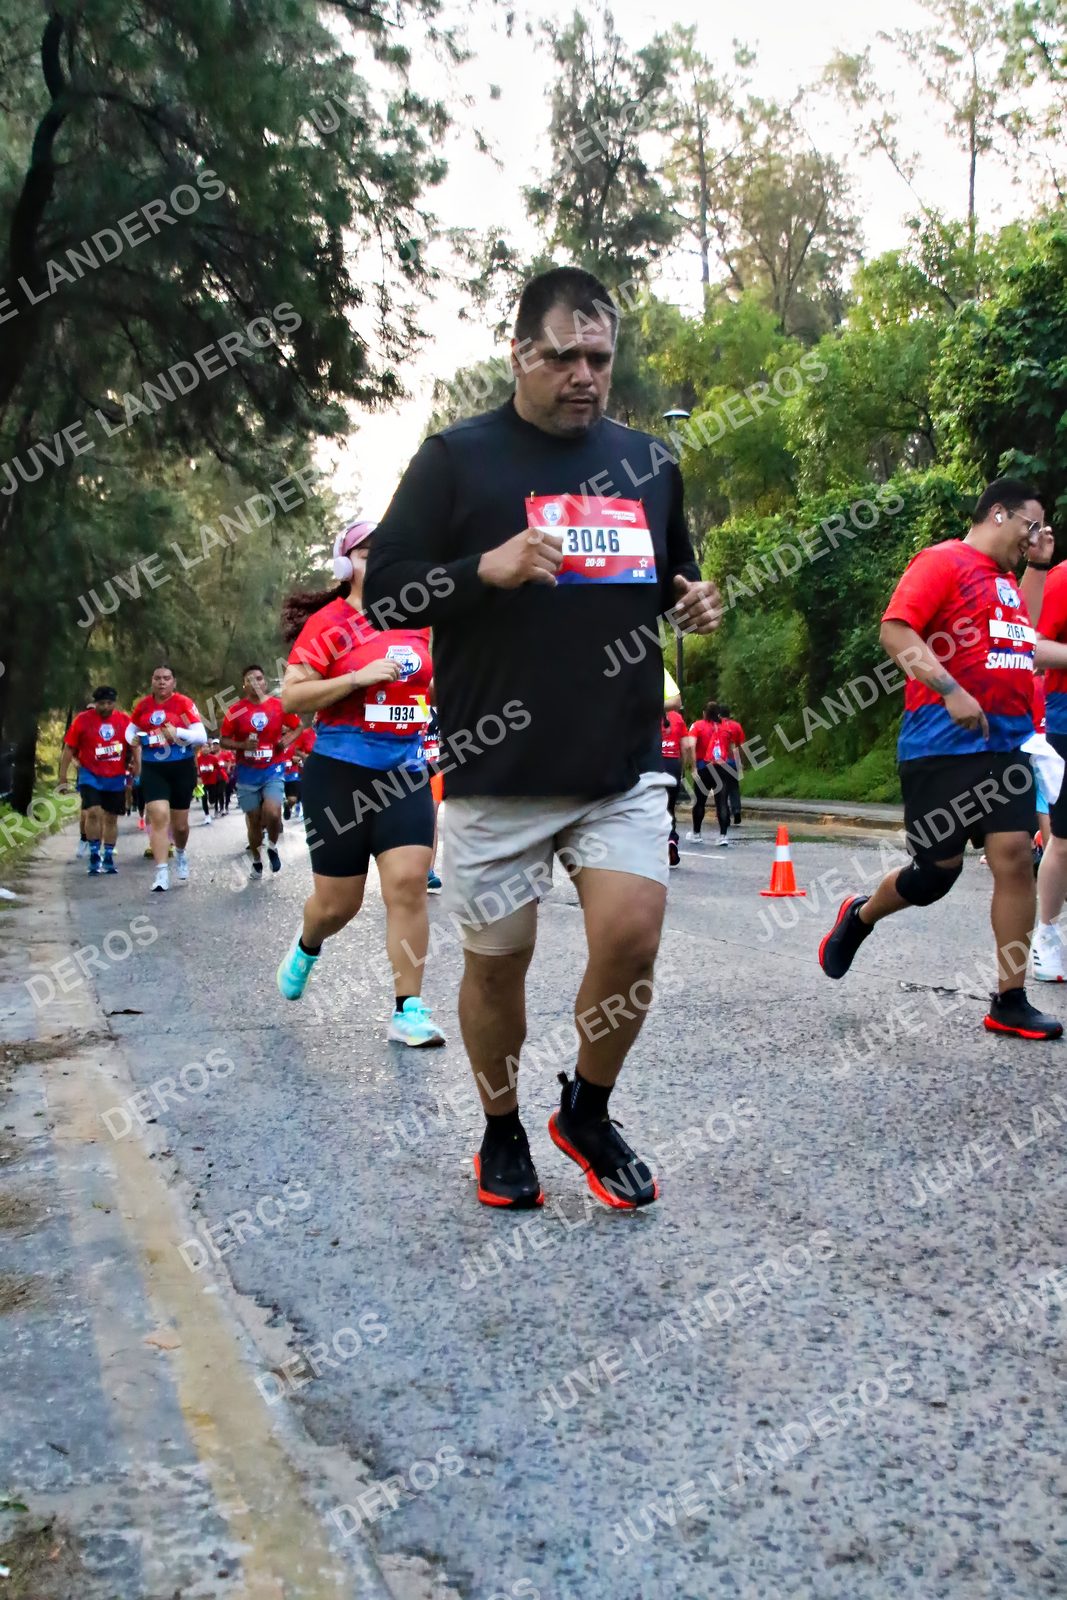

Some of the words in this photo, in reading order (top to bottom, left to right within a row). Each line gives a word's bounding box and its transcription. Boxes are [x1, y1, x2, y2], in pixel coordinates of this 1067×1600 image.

[567, 528, 620, 553] 3046
[1006, 623, 1026, 639] 2164
[389, 706, 415, 721] 1934
